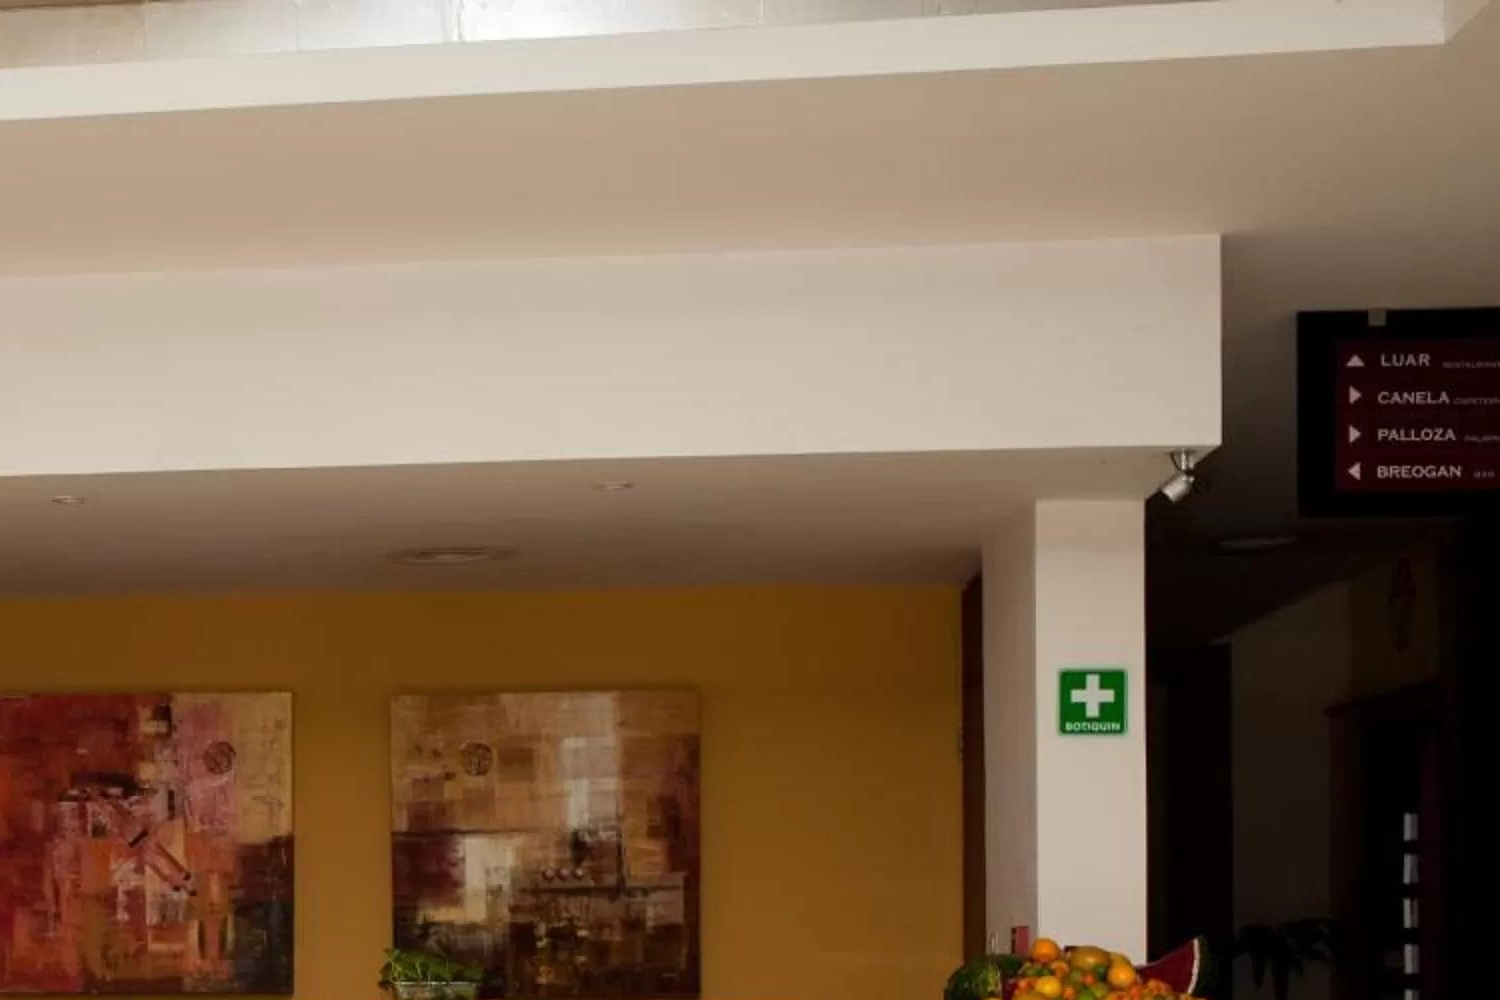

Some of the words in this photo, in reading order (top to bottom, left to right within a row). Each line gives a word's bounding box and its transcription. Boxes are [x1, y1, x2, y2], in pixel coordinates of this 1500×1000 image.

[1380, 354, 1431, 367] LUAR
[1377, 391, 1450, 405] CANELA
[1377, 428, 1456, 441] PALLOZA
[1376, 465, 1462, 479] BREOGAN
[1065, 721, 1121, 731] BOTIQUIN
